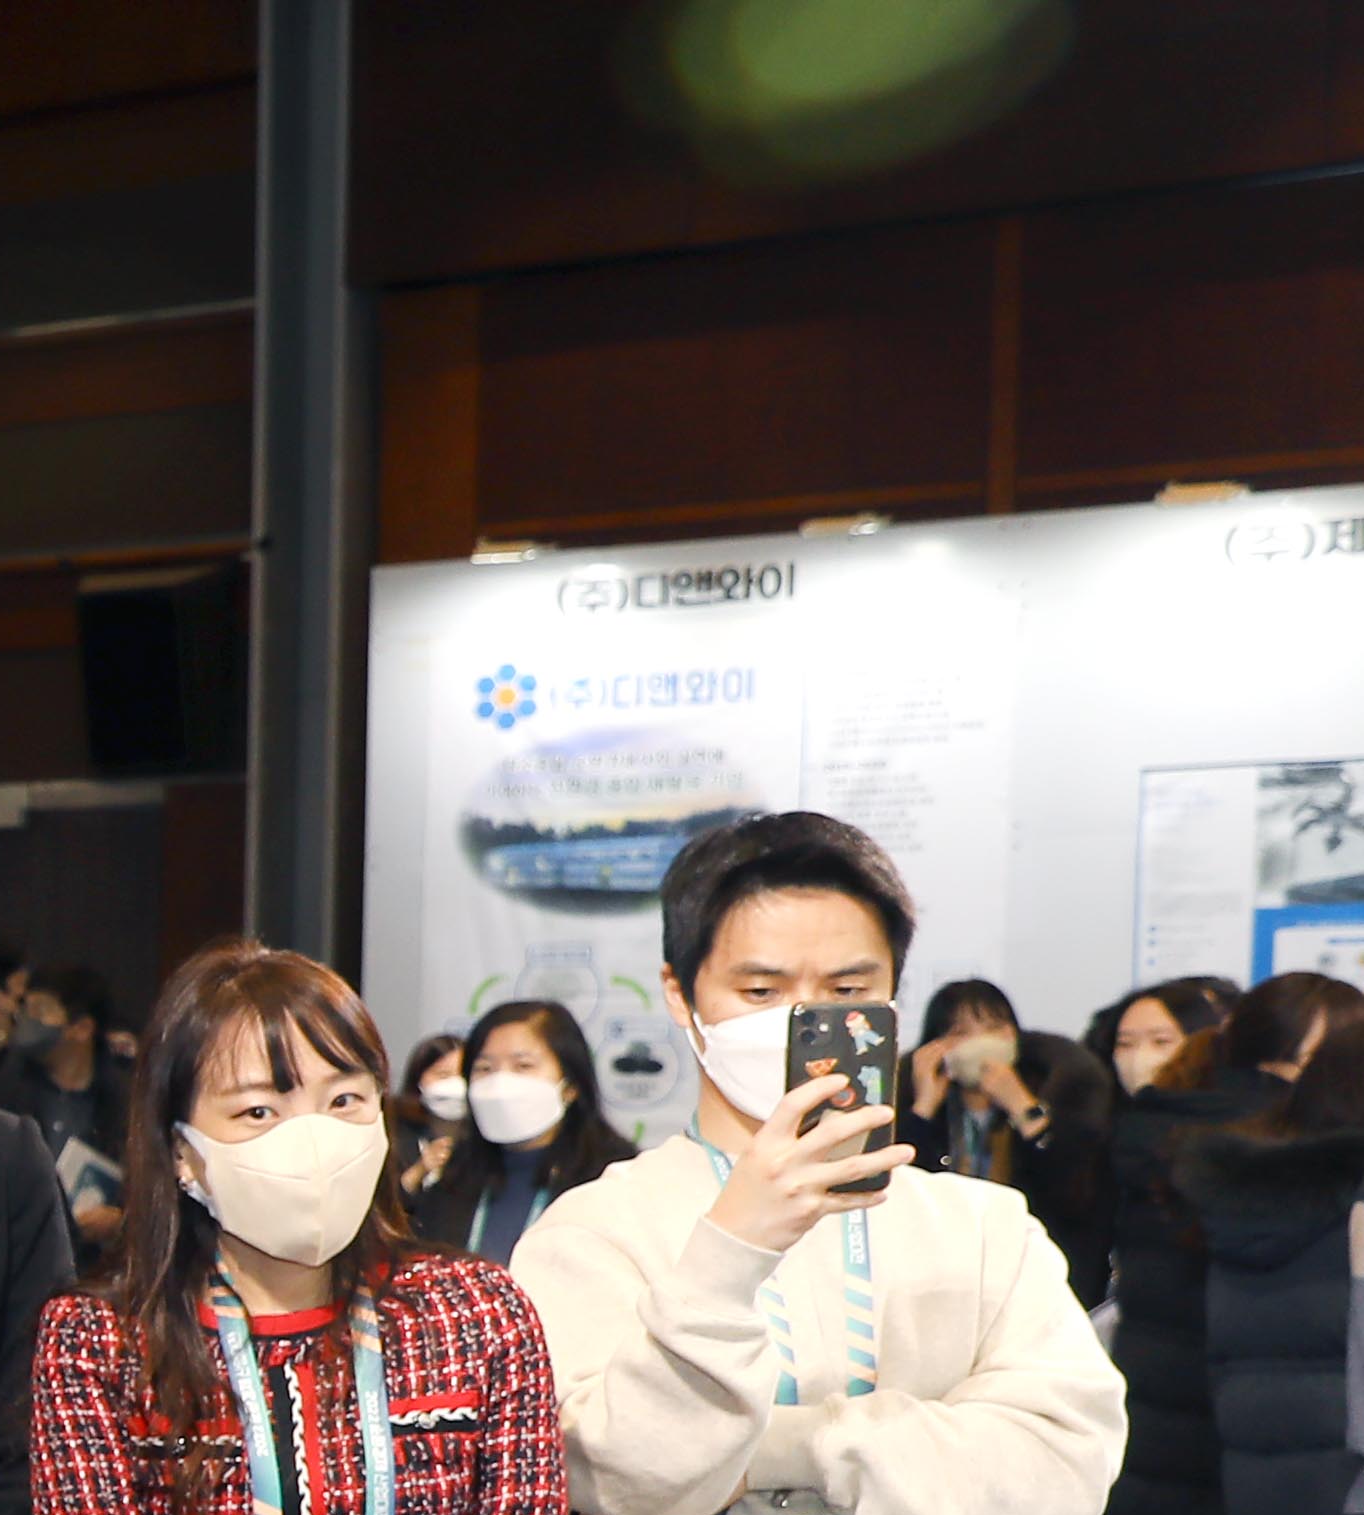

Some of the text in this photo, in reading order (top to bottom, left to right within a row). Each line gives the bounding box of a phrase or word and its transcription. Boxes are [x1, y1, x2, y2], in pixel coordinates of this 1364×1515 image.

[558, 561, 795, 616] (주)디앤와이
[550, 666, 756, 710] (주)디앤와이
[365, 1391, 379, 1423] 2022
